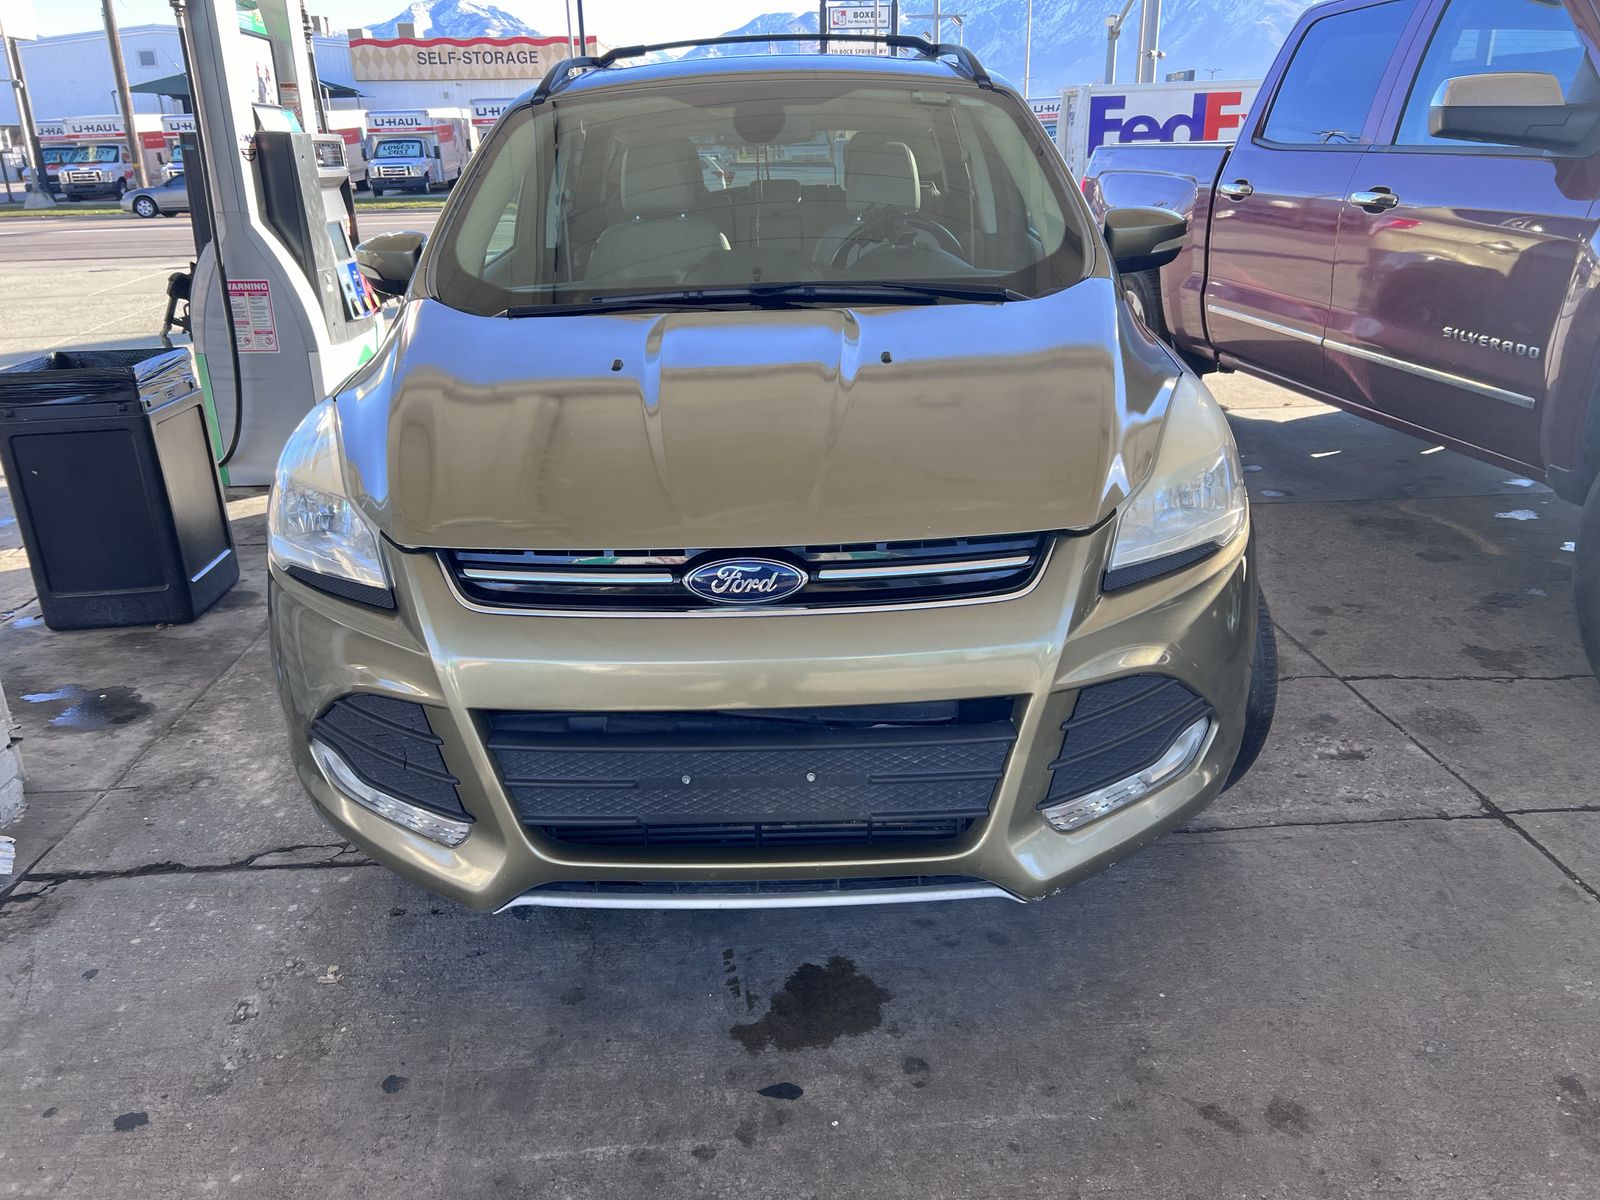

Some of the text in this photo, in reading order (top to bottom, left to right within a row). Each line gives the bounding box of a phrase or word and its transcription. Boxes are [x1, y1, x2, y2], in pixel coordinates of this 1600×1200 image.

[853, 11, 881, 19] BOXE
[417, 50, 538, 66] SELF-STORAGE
[72, 123, 120, 133] U-HAUL
[374, 117, 422, 127] U-HAUL
[1087, 91, 1247, 158] FedE
[383, 143, 416, 151] LOWEST
[1442, 326, 1540, 359] SILVERADO
[710, 565, 779, 594] Ford
